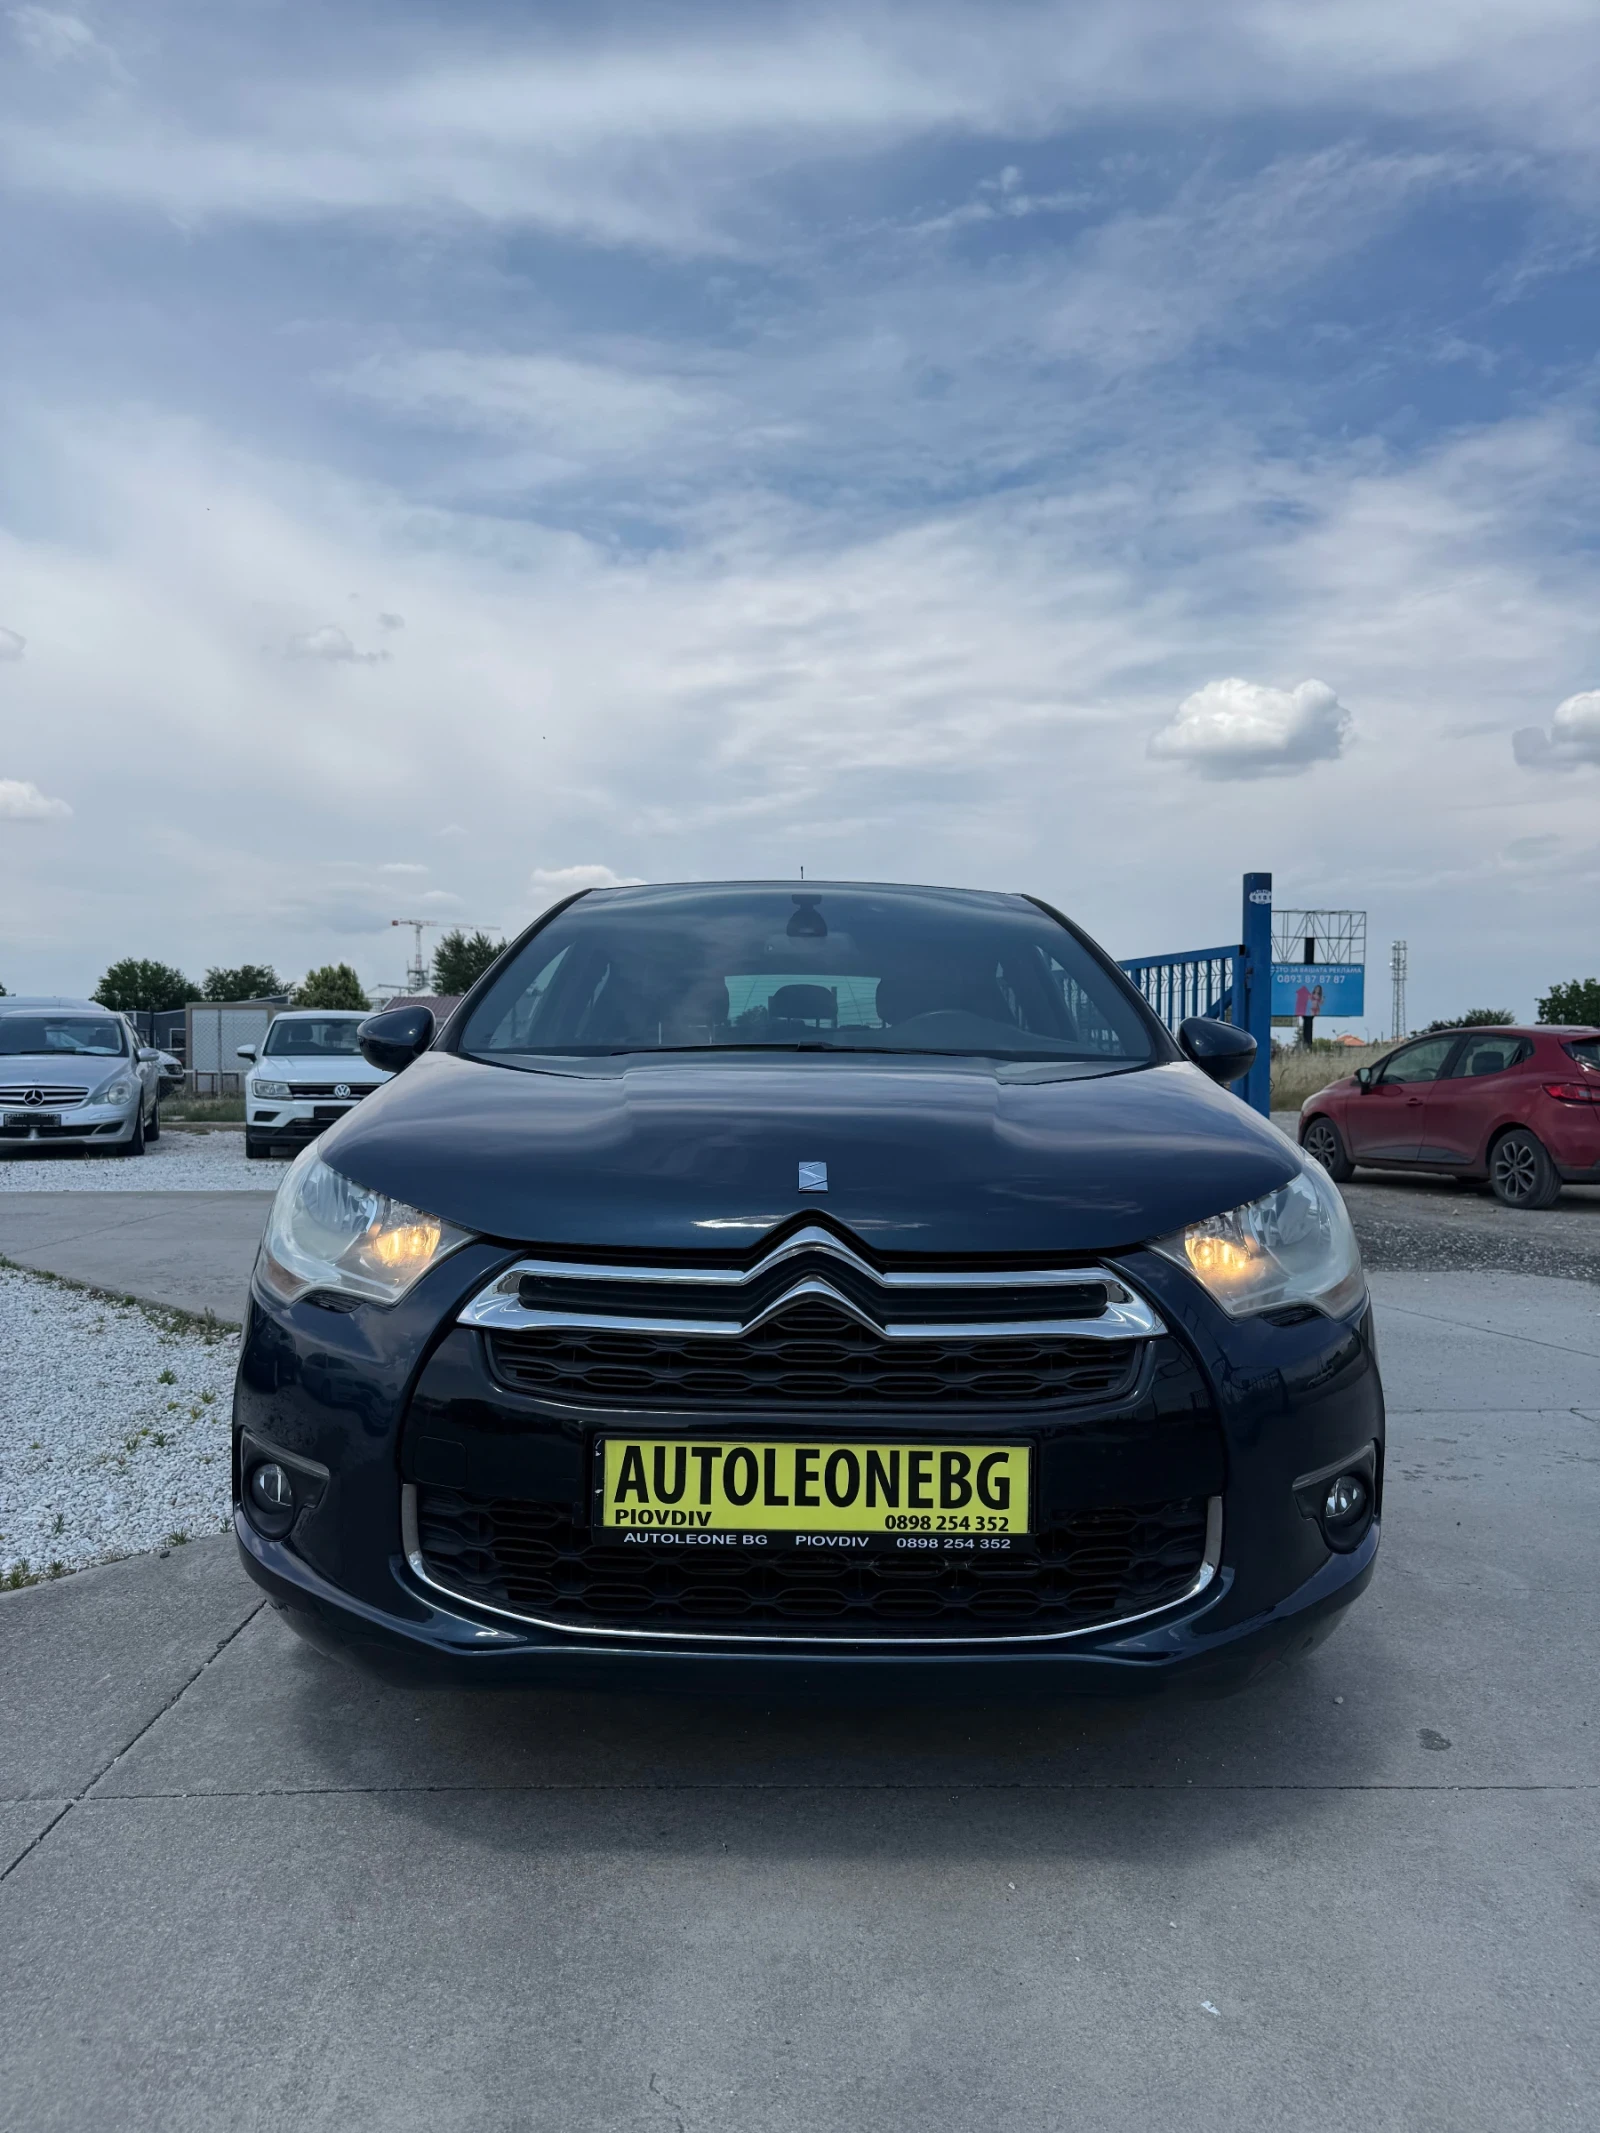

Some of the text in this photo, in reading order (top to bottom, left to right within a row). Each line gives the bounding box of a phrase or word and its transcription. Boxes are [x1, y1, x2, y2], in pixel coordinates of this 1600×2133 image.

[1277, 974, 1345, 984] 0893 87 87 87
[614, 1445, 1010, 1510] AUTOLEONEBG
[885, 1514, 1009, 1532] 0898 254 352
[623, 1532, 737, 1545] AUTOLEONE
[742, 1534, 768, 1545] BG
[896, 1538, 938, 1549] 0898
[944, 1538, 975, 1549] 254
[980, 1538, 1011, 1549] 352
